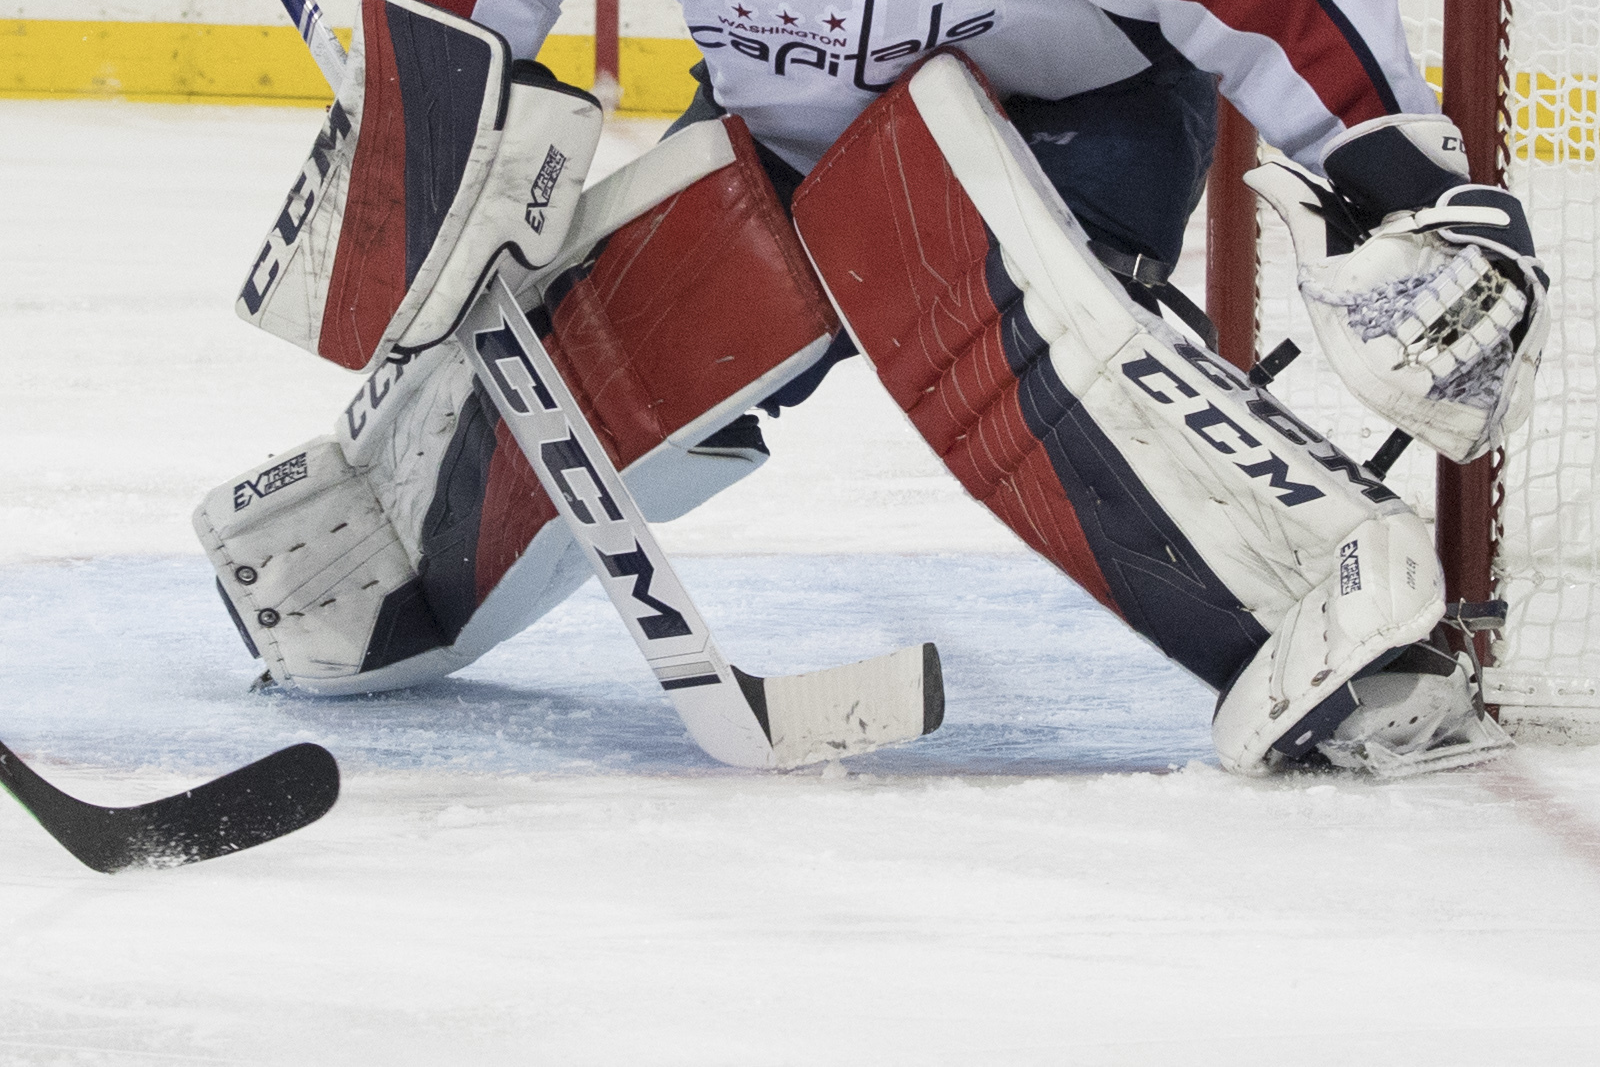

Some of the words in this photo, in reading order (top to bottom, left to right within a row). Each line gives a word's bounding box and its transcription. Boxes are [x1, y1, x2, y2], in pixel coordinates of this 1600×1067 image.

[717, 14, 848, 48] WASHINGTON
[238, 98, 352, 316] CCM
[474, 317, 695, 641] CCM
[1121, 349, 1327, 509] CCM
